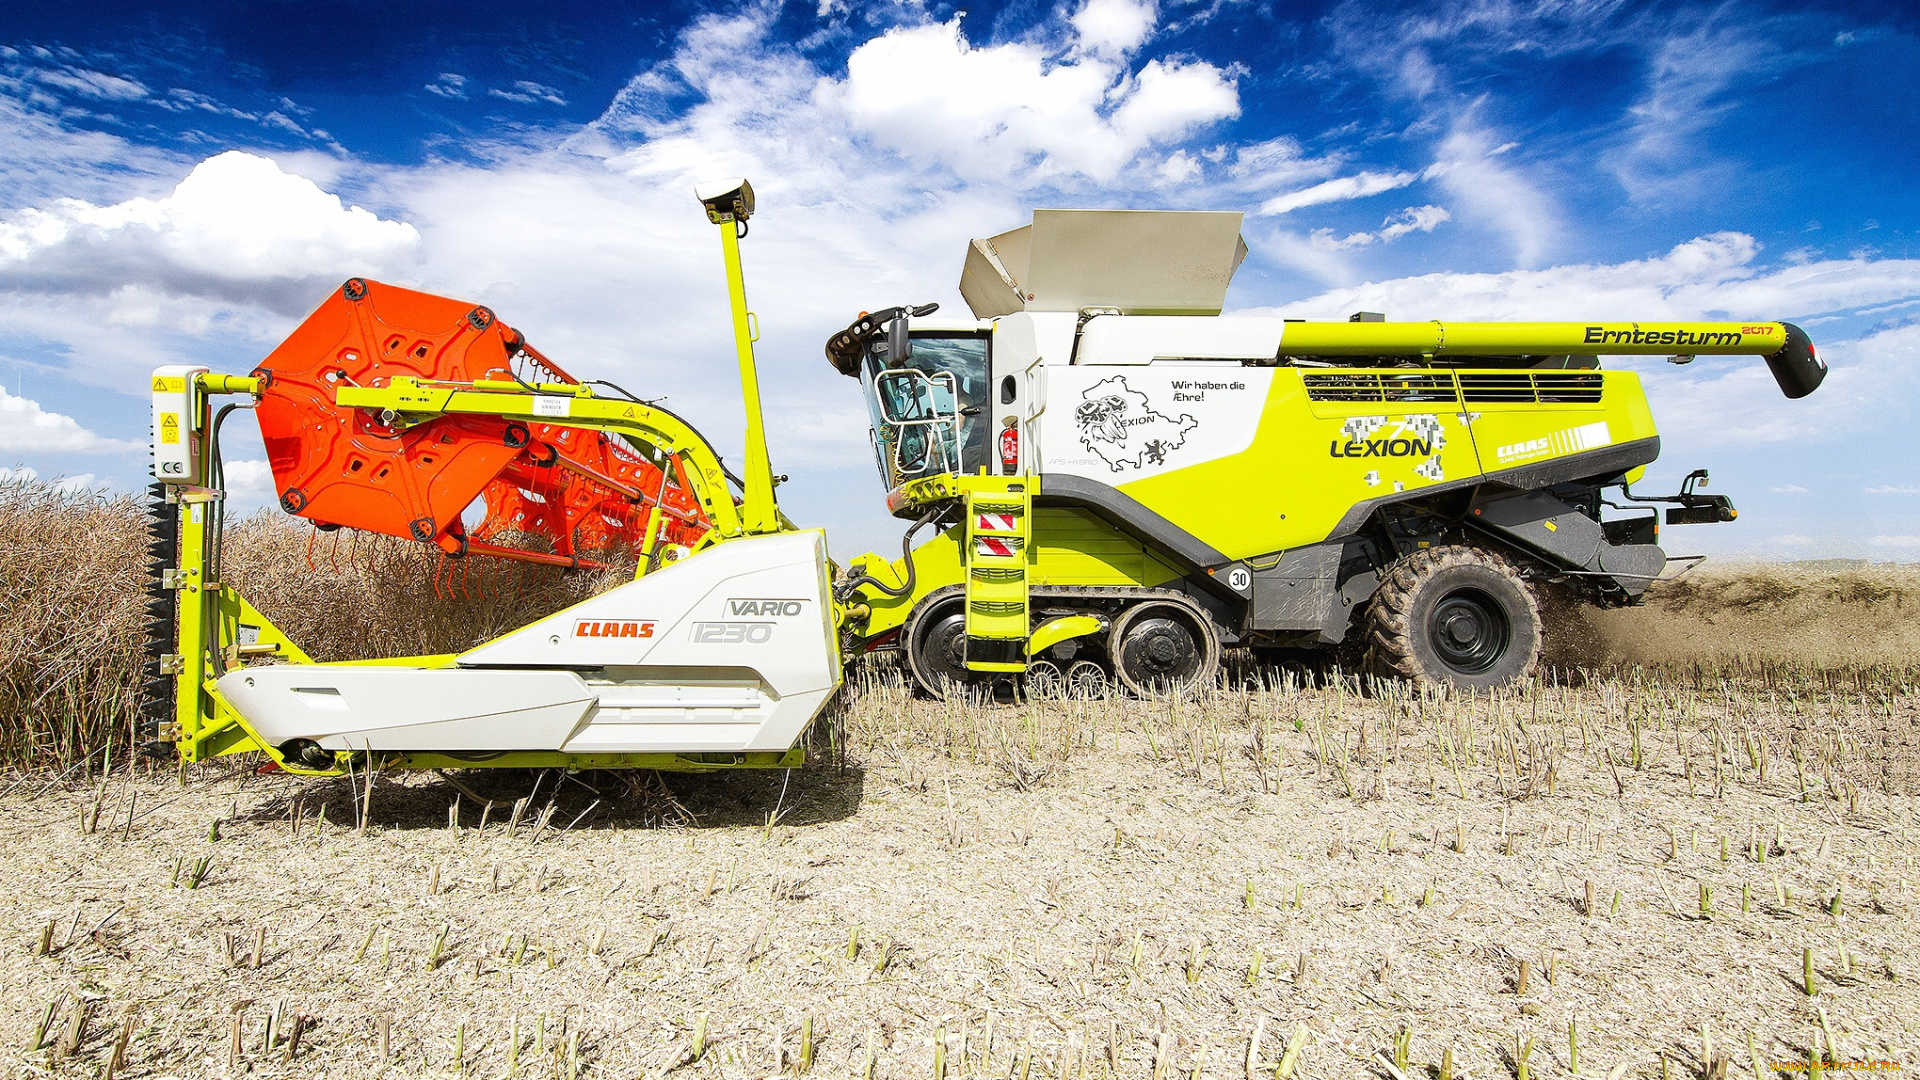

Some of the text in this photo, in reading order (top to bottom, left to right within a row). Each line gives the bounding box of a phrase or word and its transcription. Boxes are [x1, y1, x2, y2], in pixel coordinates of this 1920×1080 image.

[1584, 326, 1774, 346] Erntesturm 2017
[1171, 380, 1246, 390] Wir haben die
[1330, 439, 1432, 458] LEXION
[1497, 437, 1549, 458] CLAAS
[1232, 572, 1247, 587] 30
[730, 601, 802, 616] VARIO
[576, 622, 655, 638] CLAAS
[693, 624, 773, 644] 1230
